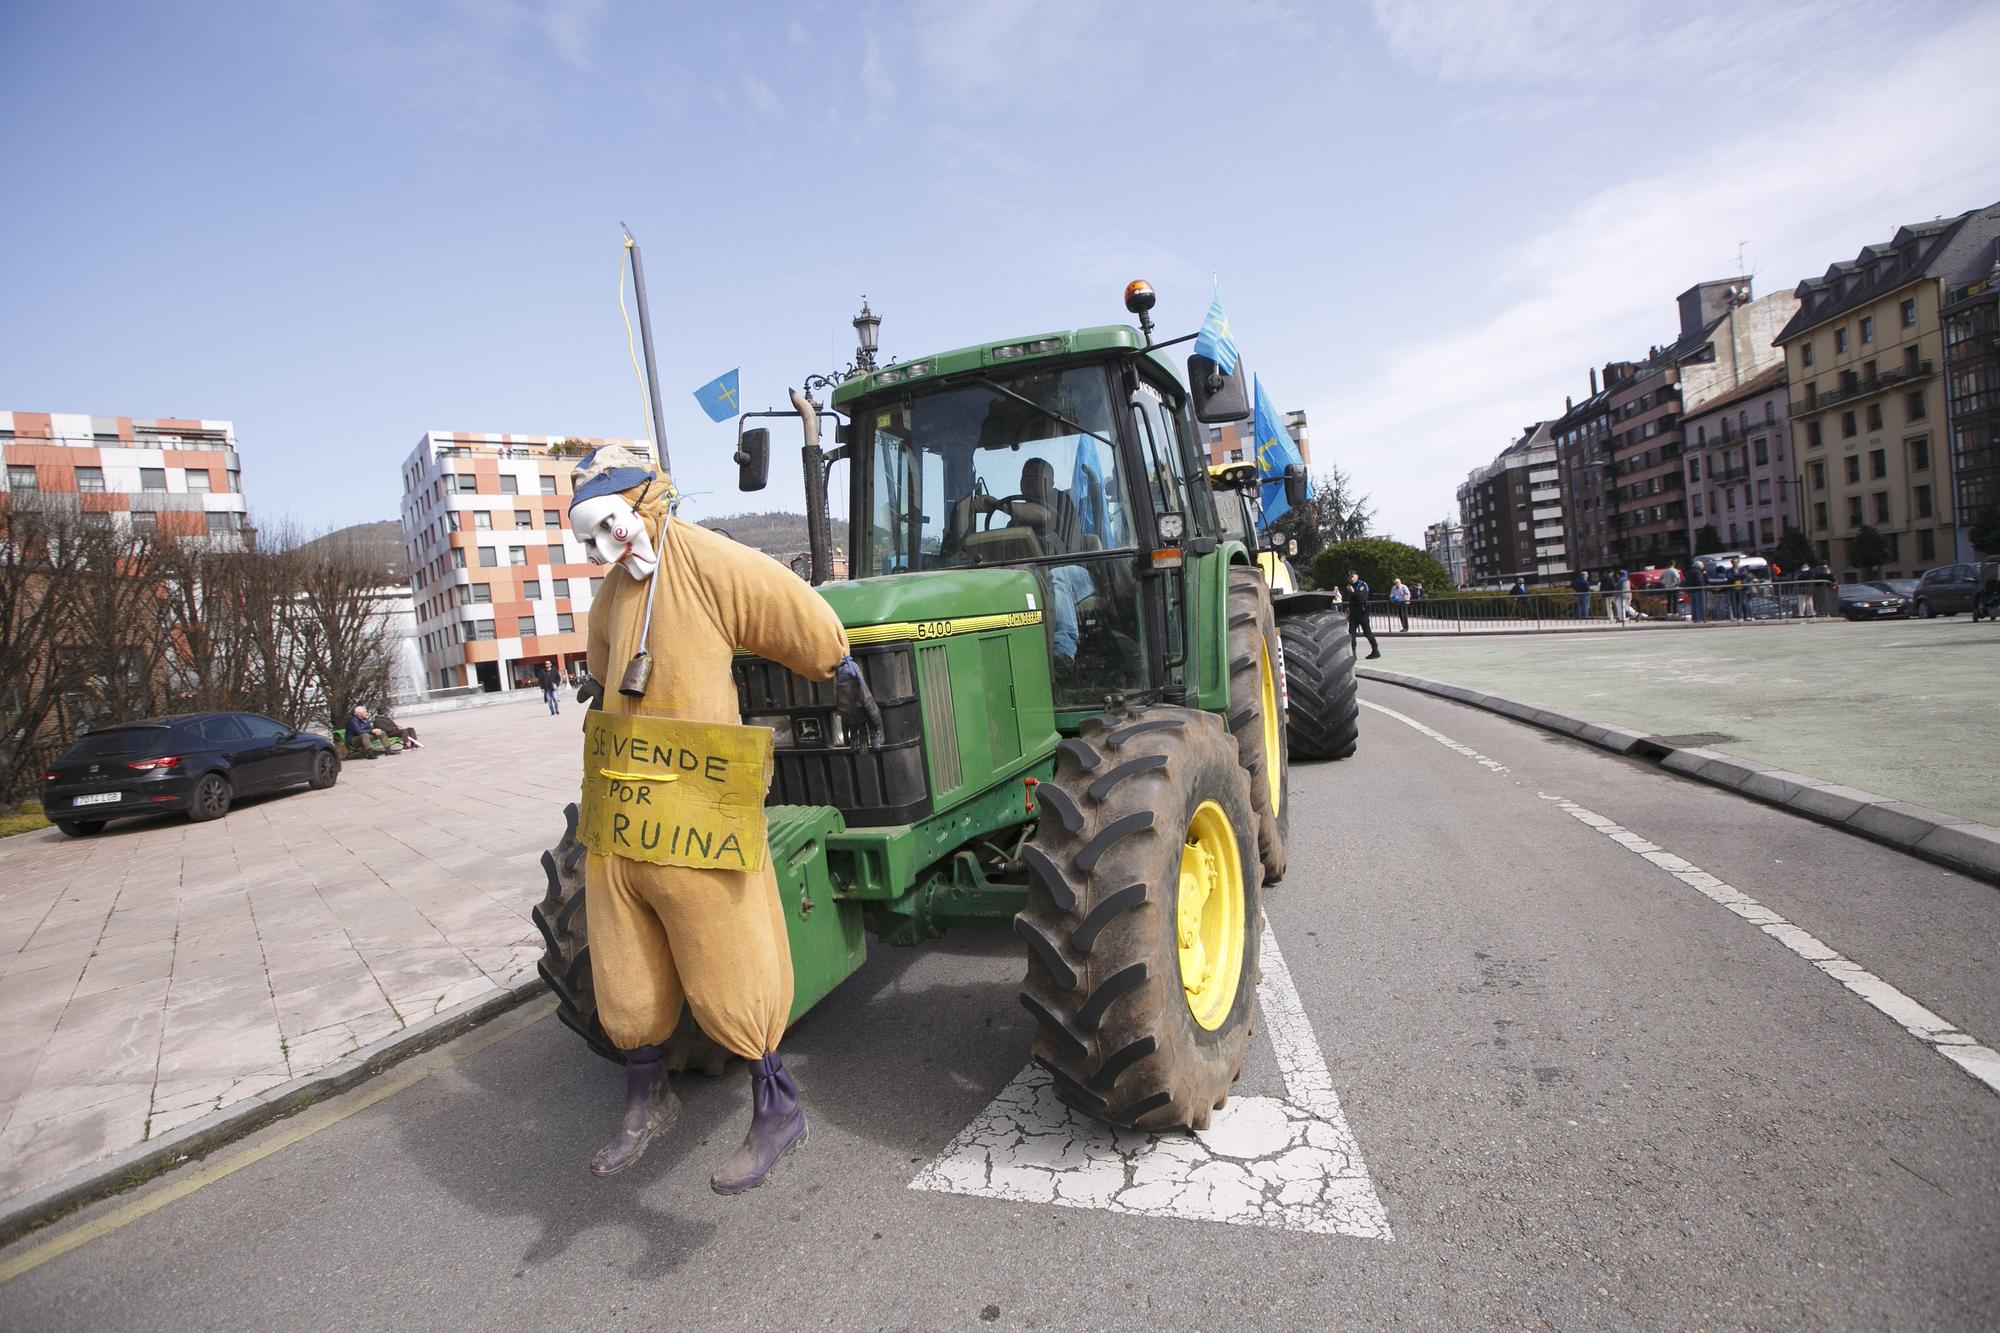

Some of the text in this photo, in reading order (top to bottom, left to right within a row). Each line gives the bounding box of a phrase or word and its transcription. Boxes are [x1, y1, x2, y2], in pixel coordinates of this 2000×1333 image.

[918, 622, 952, 637] 6400
[1007, 613, 1023, 626] JOHN
[592, 726, 606, 756] SE
[613, 734, 729, 783] VENDE
[609, 779, 652, 805] POR
[613, 813, 746, 867] RUINA
